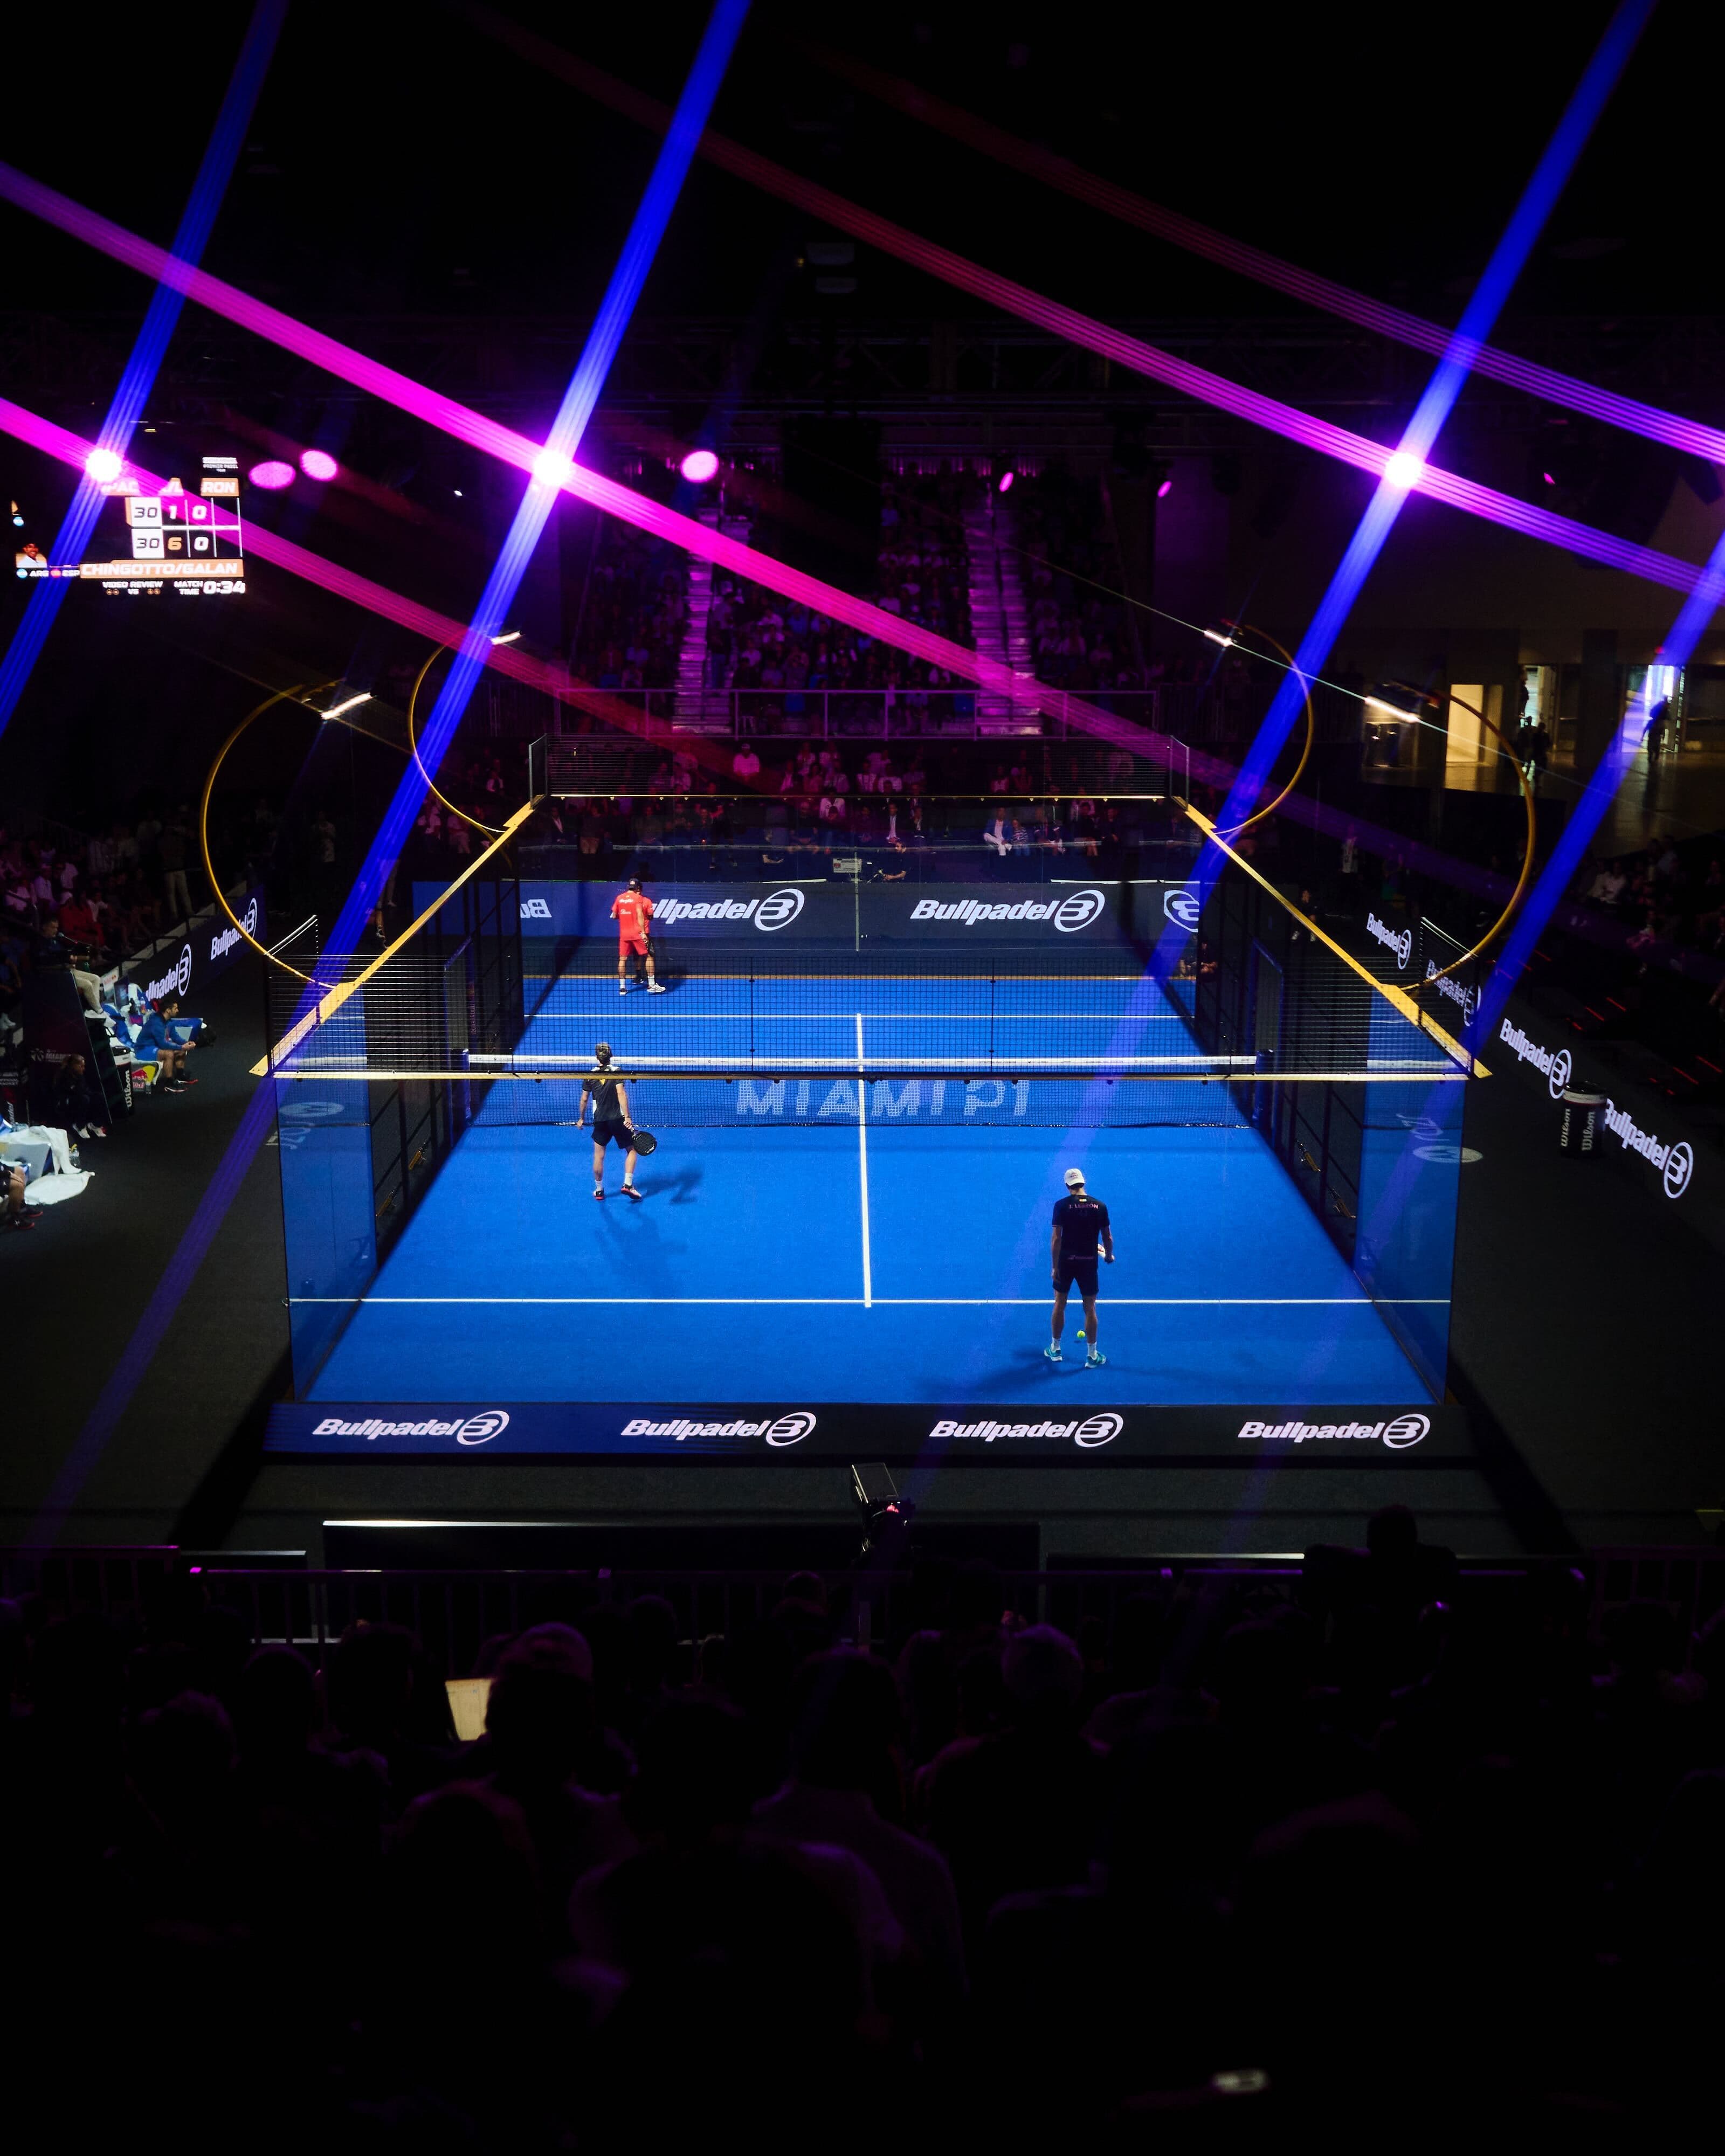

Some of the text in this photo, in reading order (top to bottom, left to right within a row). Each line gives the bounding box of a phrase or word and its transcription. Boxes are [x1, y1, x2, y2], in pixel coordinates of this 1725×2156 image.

[135, 507, 157, 518] 30
[169, 505, 177, 520] 1
[191, 505, 207, 520] 0
[136, 538, 159, 549] 30
[168, 537, 182, 551] 6
[194, 536, 209, 551] 0
[82, 563, 238, 575] CHINGOTTO/GALAN
[203, 581, 245, 595] 0:34
[910, 900, 1060, 925] Bullpadel
[1367, 913, 1401, 953] Bullpadel
[1500, 1018, 1555, 1076] Bullpadel
[737, 1079, 1029, 1116] MIAMI P1
[1560, 1108, 1571, 1147] Wilson
[1581, 1111, 1596, 1151] Wilson
[1604, 1098, 1670, 1170] Bullpadel
[313, 1419, 464, 1440] Bullpadel
[621, 1420, 771, 1441] Bullpadel
[929, 1421, 1079, 1442] Bullpadel
[1238, 1422, 1385, 1443] Bullpadel
